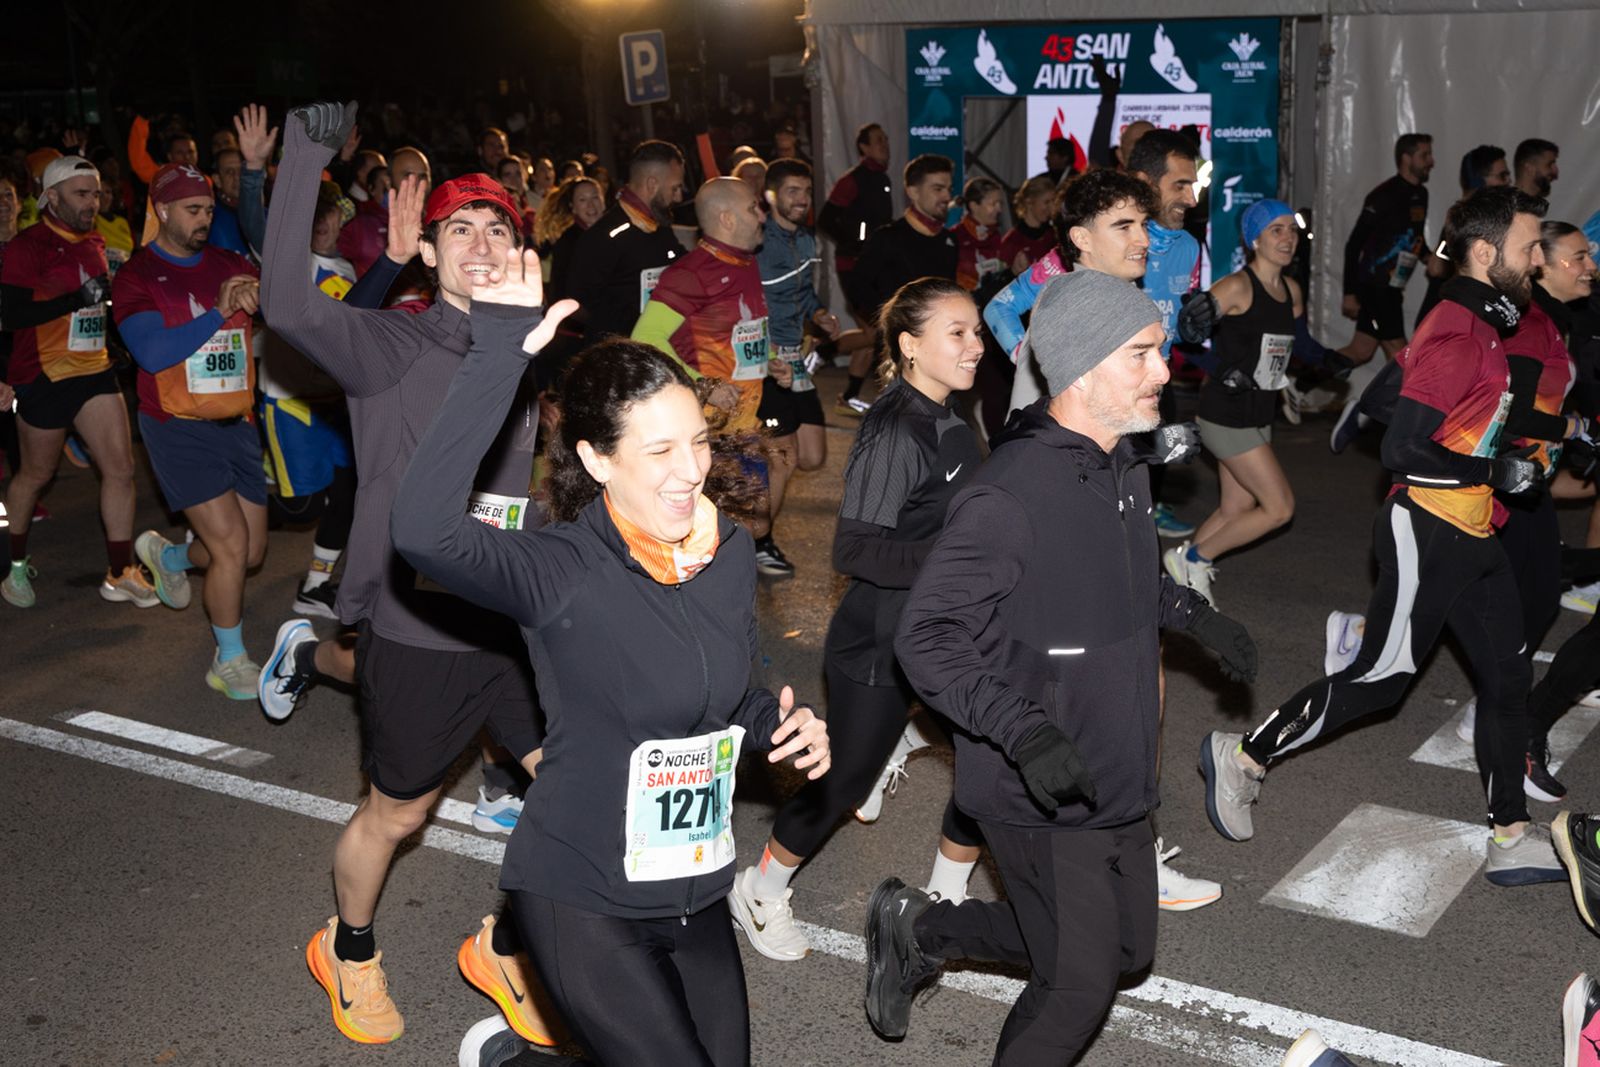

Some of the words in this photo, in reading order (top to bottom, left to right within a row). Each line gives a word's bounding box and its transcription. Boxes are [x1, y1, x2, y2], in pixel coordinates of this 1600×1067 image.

[272, 60, 305, 82] WC
[630, 41, 659, 96] P
[987, 66, 1003, 84] 43
[1164, 62, 1182, 82] 43
[1214, 126, 1272, 138] calderón
[743, 338, 766, 361] 642
[206, 352, 236, 372] 986
[491, 507, 504, 519] DE
[665, 752, 706, 767] NOCHE
[647, 772, 675, 788] SAN
[689, 829, 712, 842] Isabel
